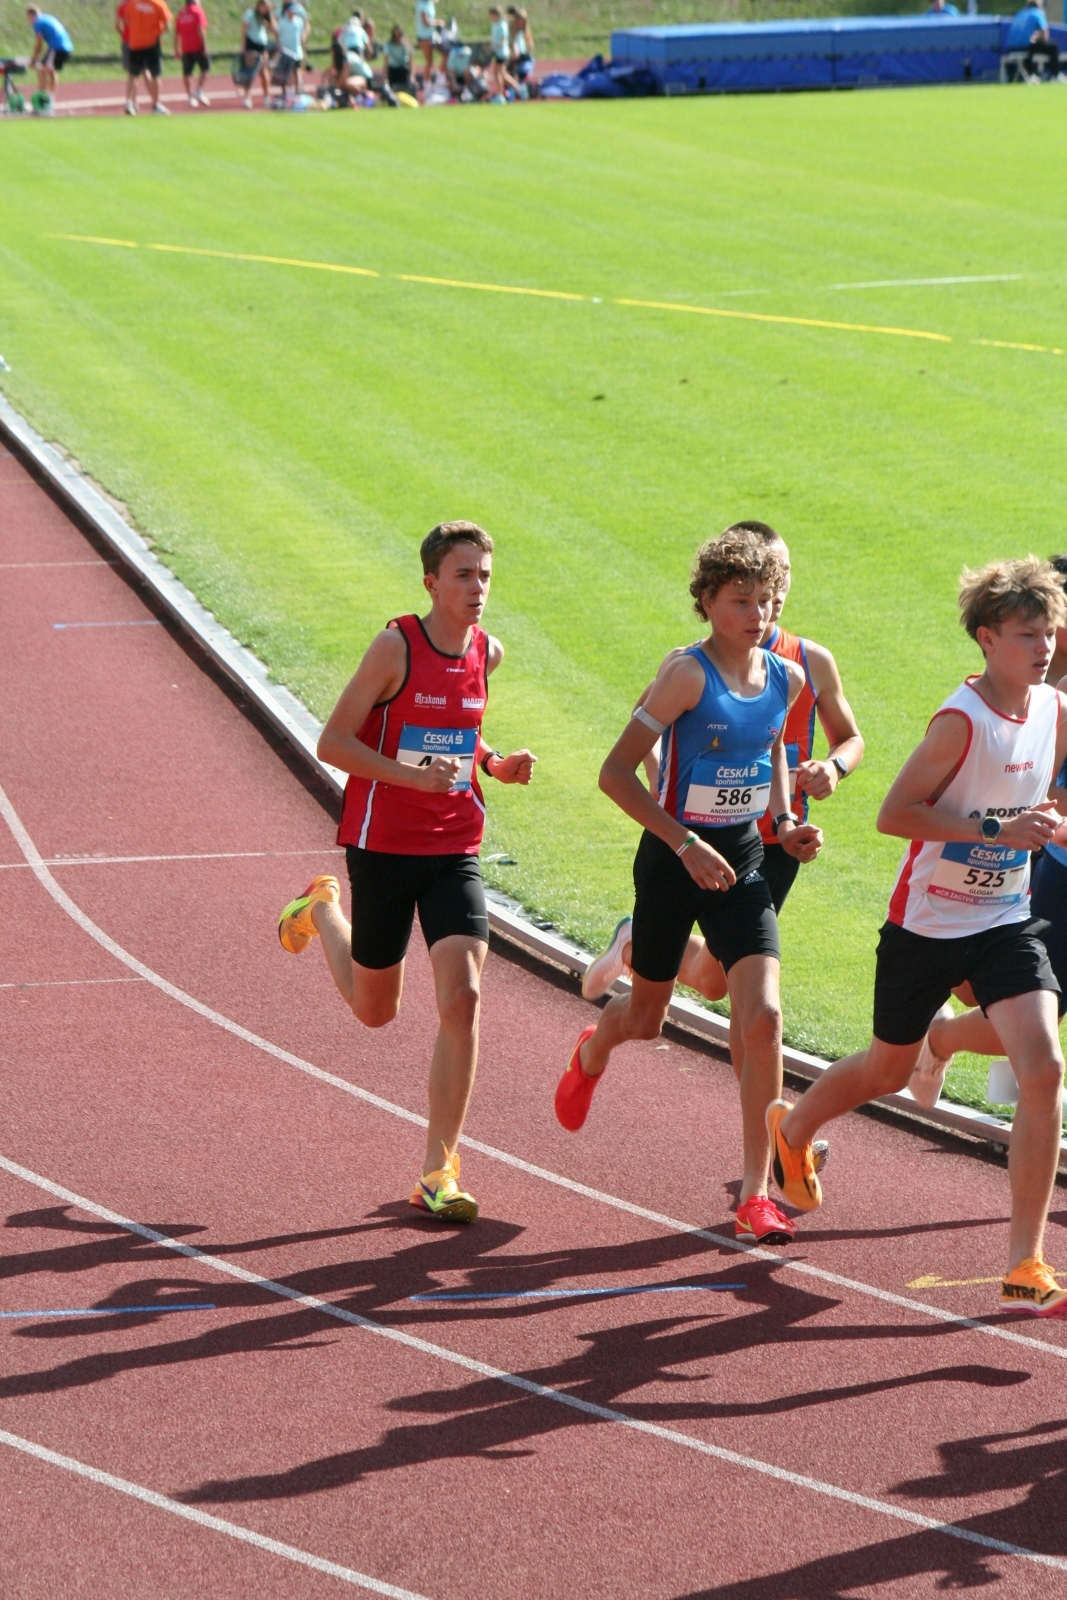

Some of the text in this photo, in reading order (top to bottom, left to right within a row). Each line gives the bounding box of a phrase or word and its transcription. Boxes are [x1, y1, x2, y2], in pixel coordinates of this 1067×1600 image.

[423, 732, 454, 744] ČESKÁ
[716, 766, 749, 778] ČESKÁ
[715, 778, 744, 786] spořitelna
[715, 788, 752, 806] 586
[985, 805, 1032, 818] SOKO
[970, 846, 1005, 861] ČESKÁ
[967, 858, 1001, 869] spořitelna
[963, 868, 1005, 888] 525
[949, 893, 974, 903] ŽACTVA
